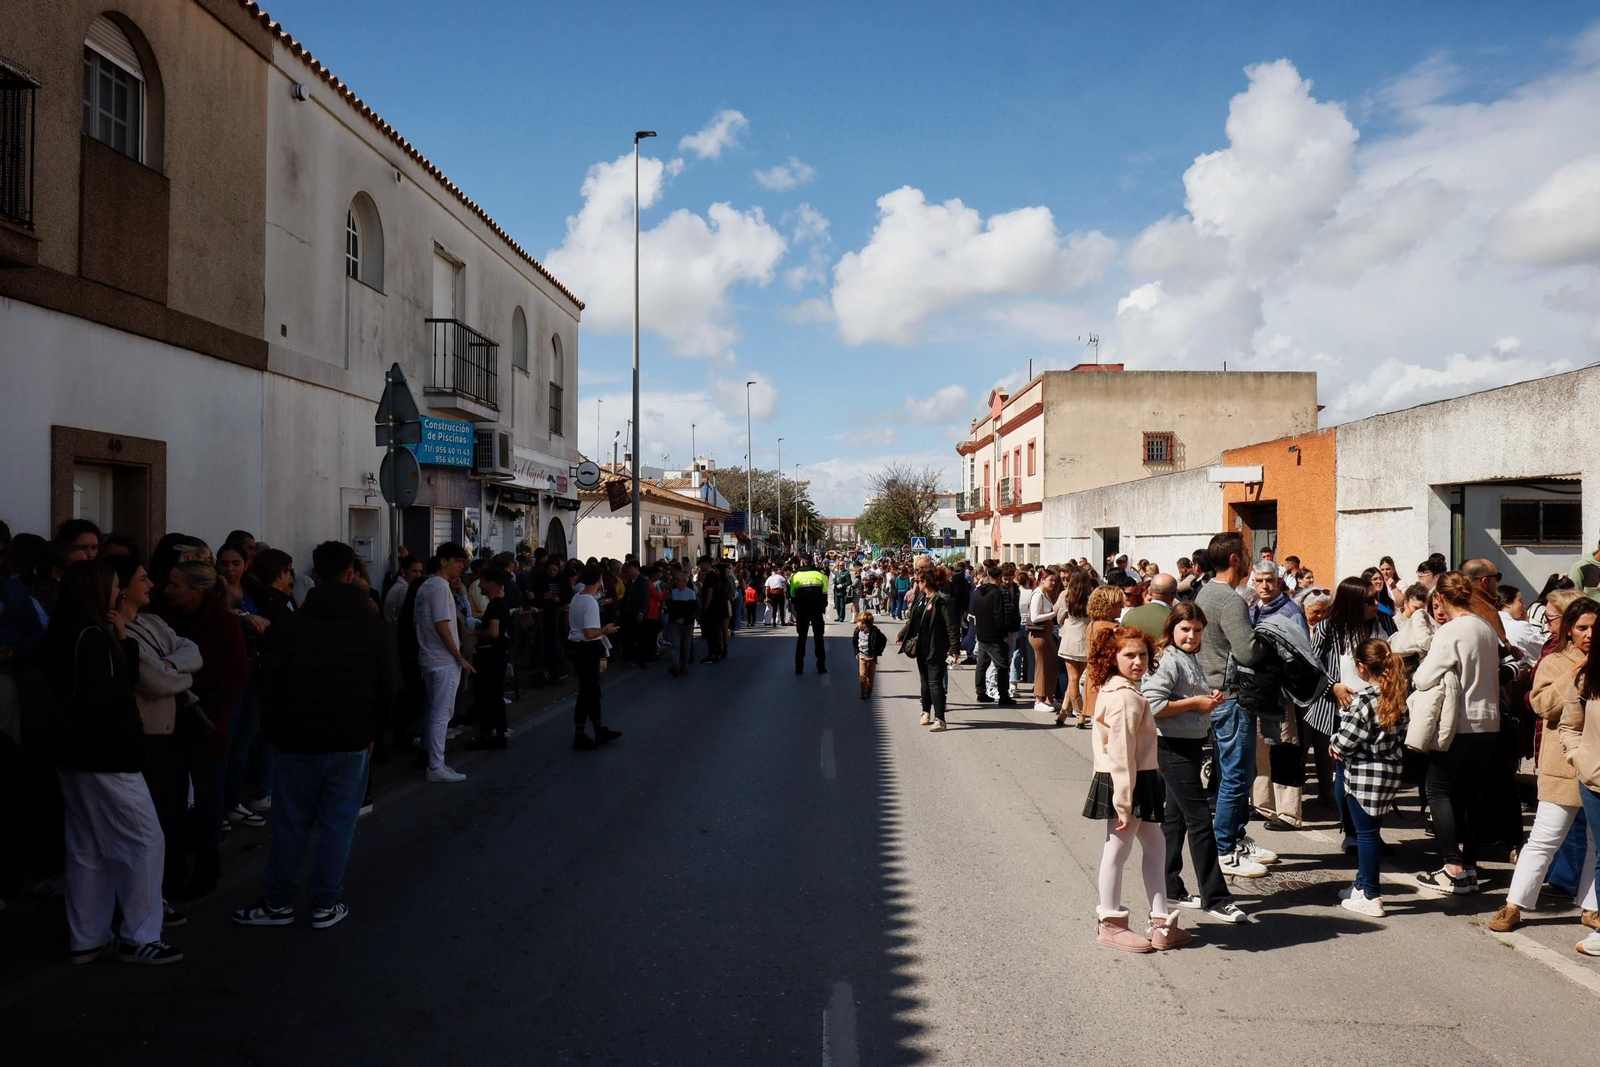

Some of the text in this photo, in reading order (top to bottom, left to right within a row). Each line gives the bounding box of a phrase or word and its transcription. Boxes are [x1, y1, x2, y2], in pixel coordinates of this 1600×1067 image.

[424, 419, 470, 433] Construcción
[428, 431, 436, 440] de
[108, 438, 122, 453] 40
[436, 446, 447, 454] 956
[456, 457, 470, 466] 5492
